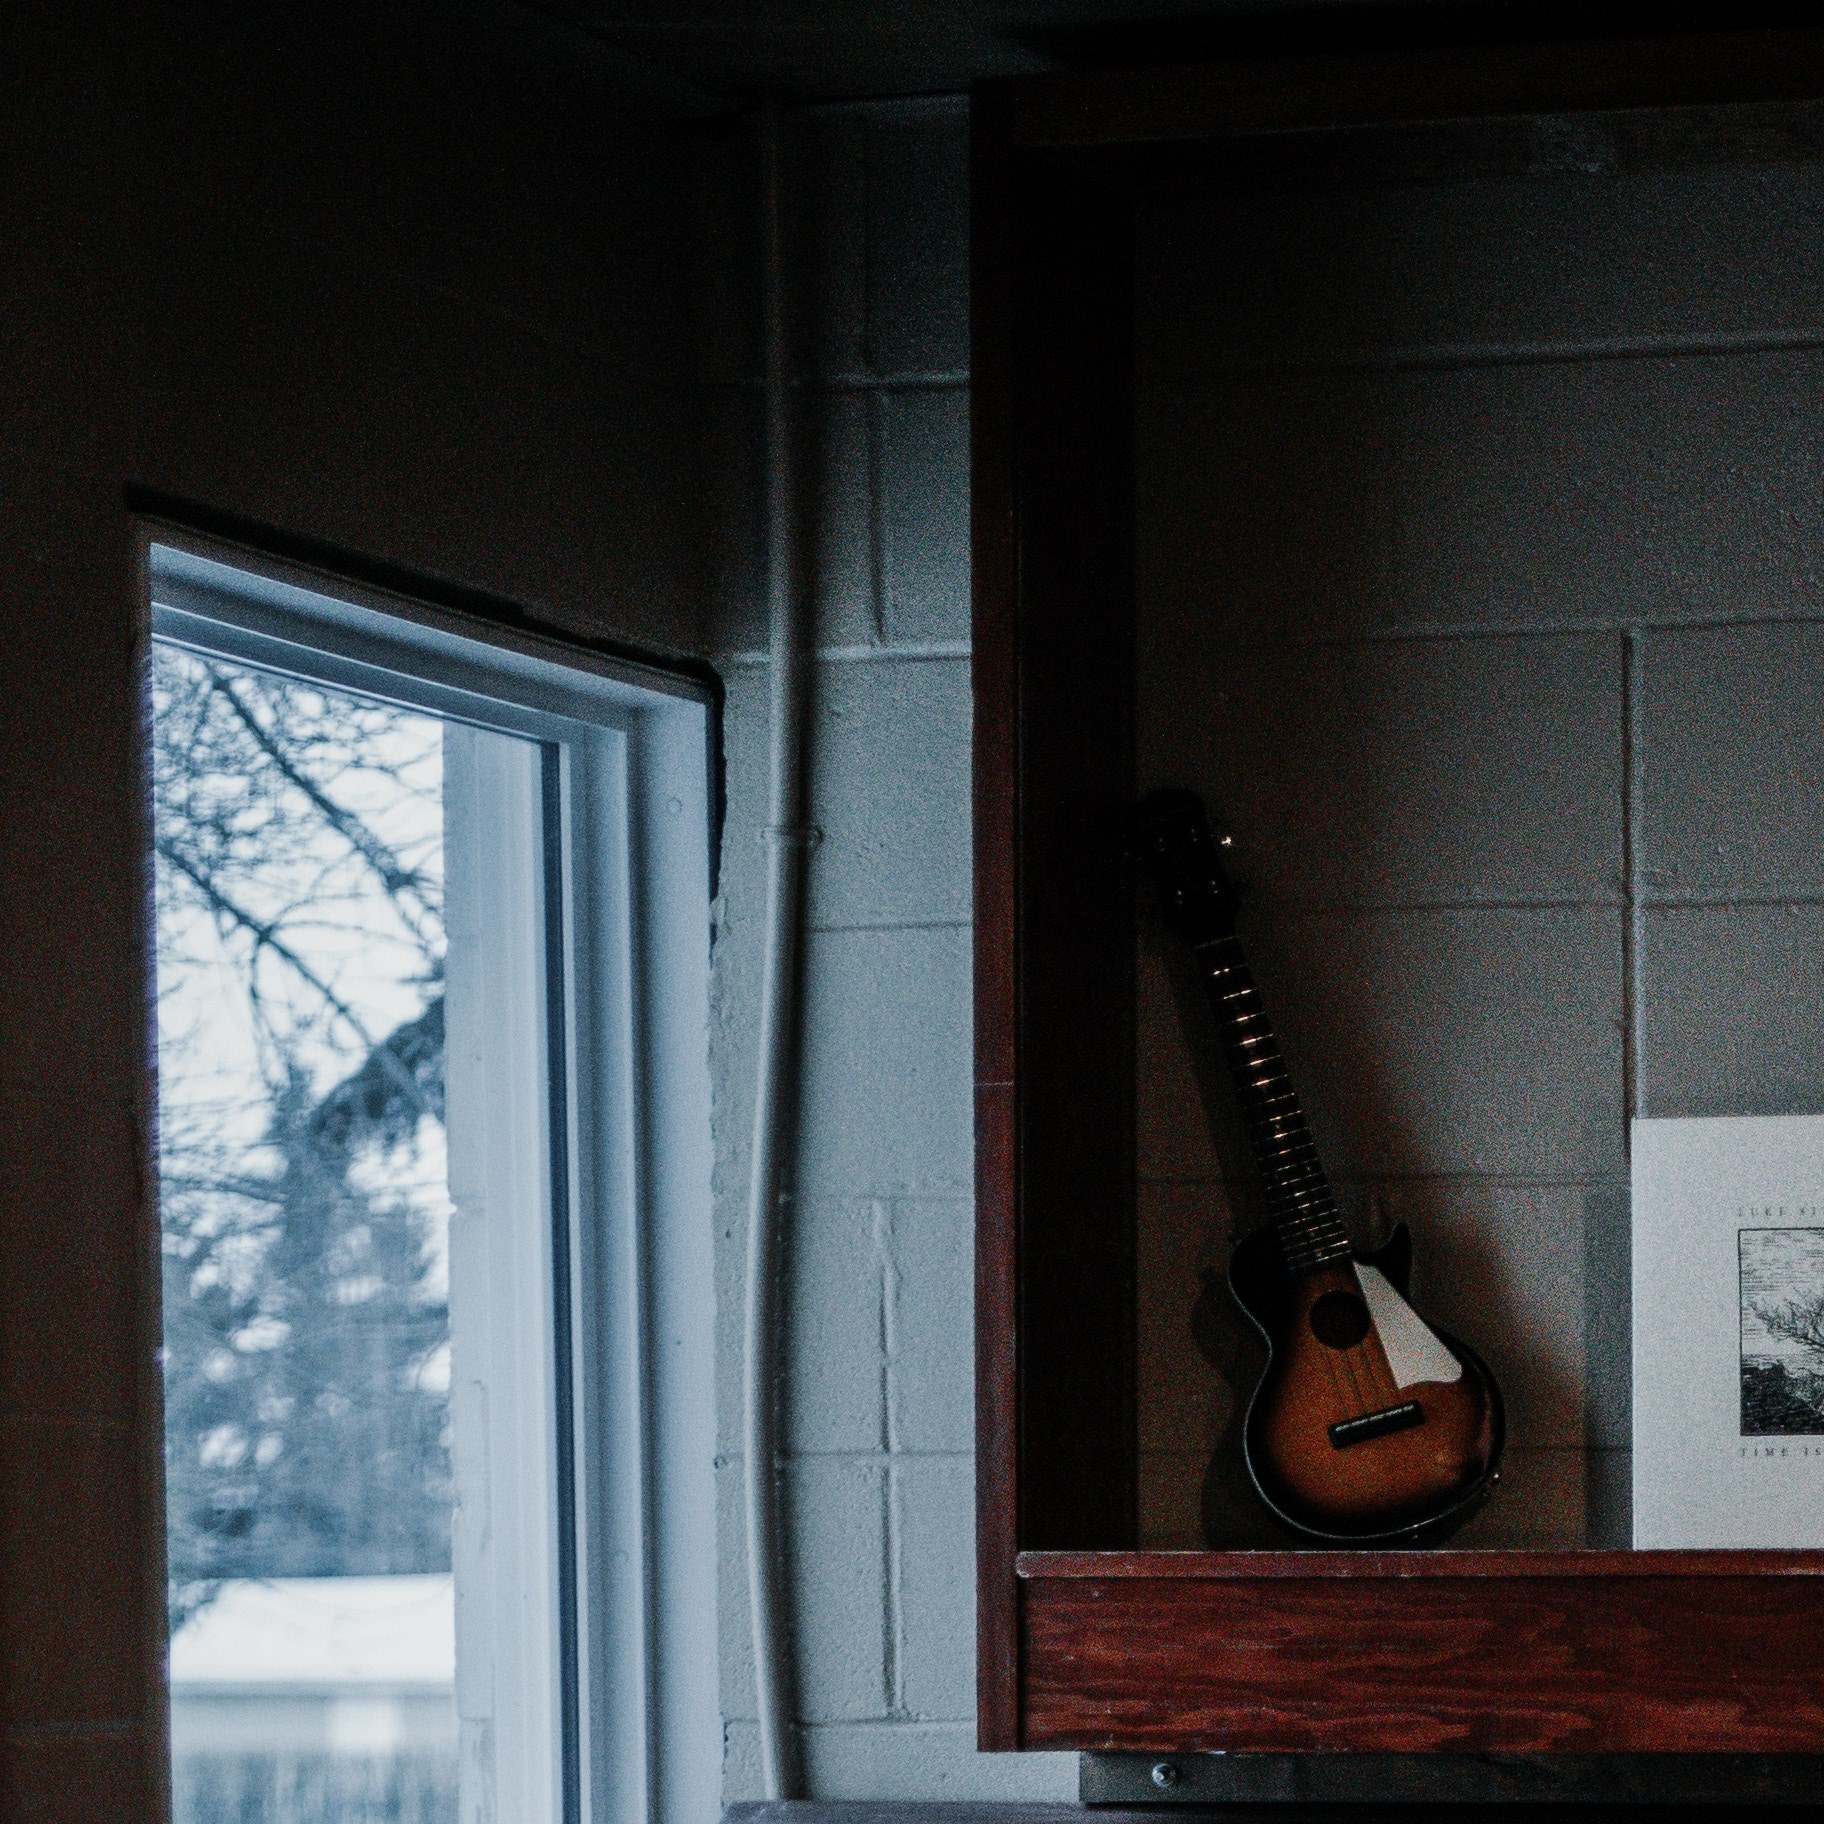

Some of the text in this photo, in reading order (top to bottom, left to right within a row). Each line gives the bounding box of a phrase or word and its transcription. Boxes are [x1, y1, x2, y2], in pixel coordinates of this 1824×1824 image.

[1738, 1206, 1785, 1217] LUKE
[1740, 1447, 1788, 1457] TIME
[1804, 1447, 1821, 1456] IS
